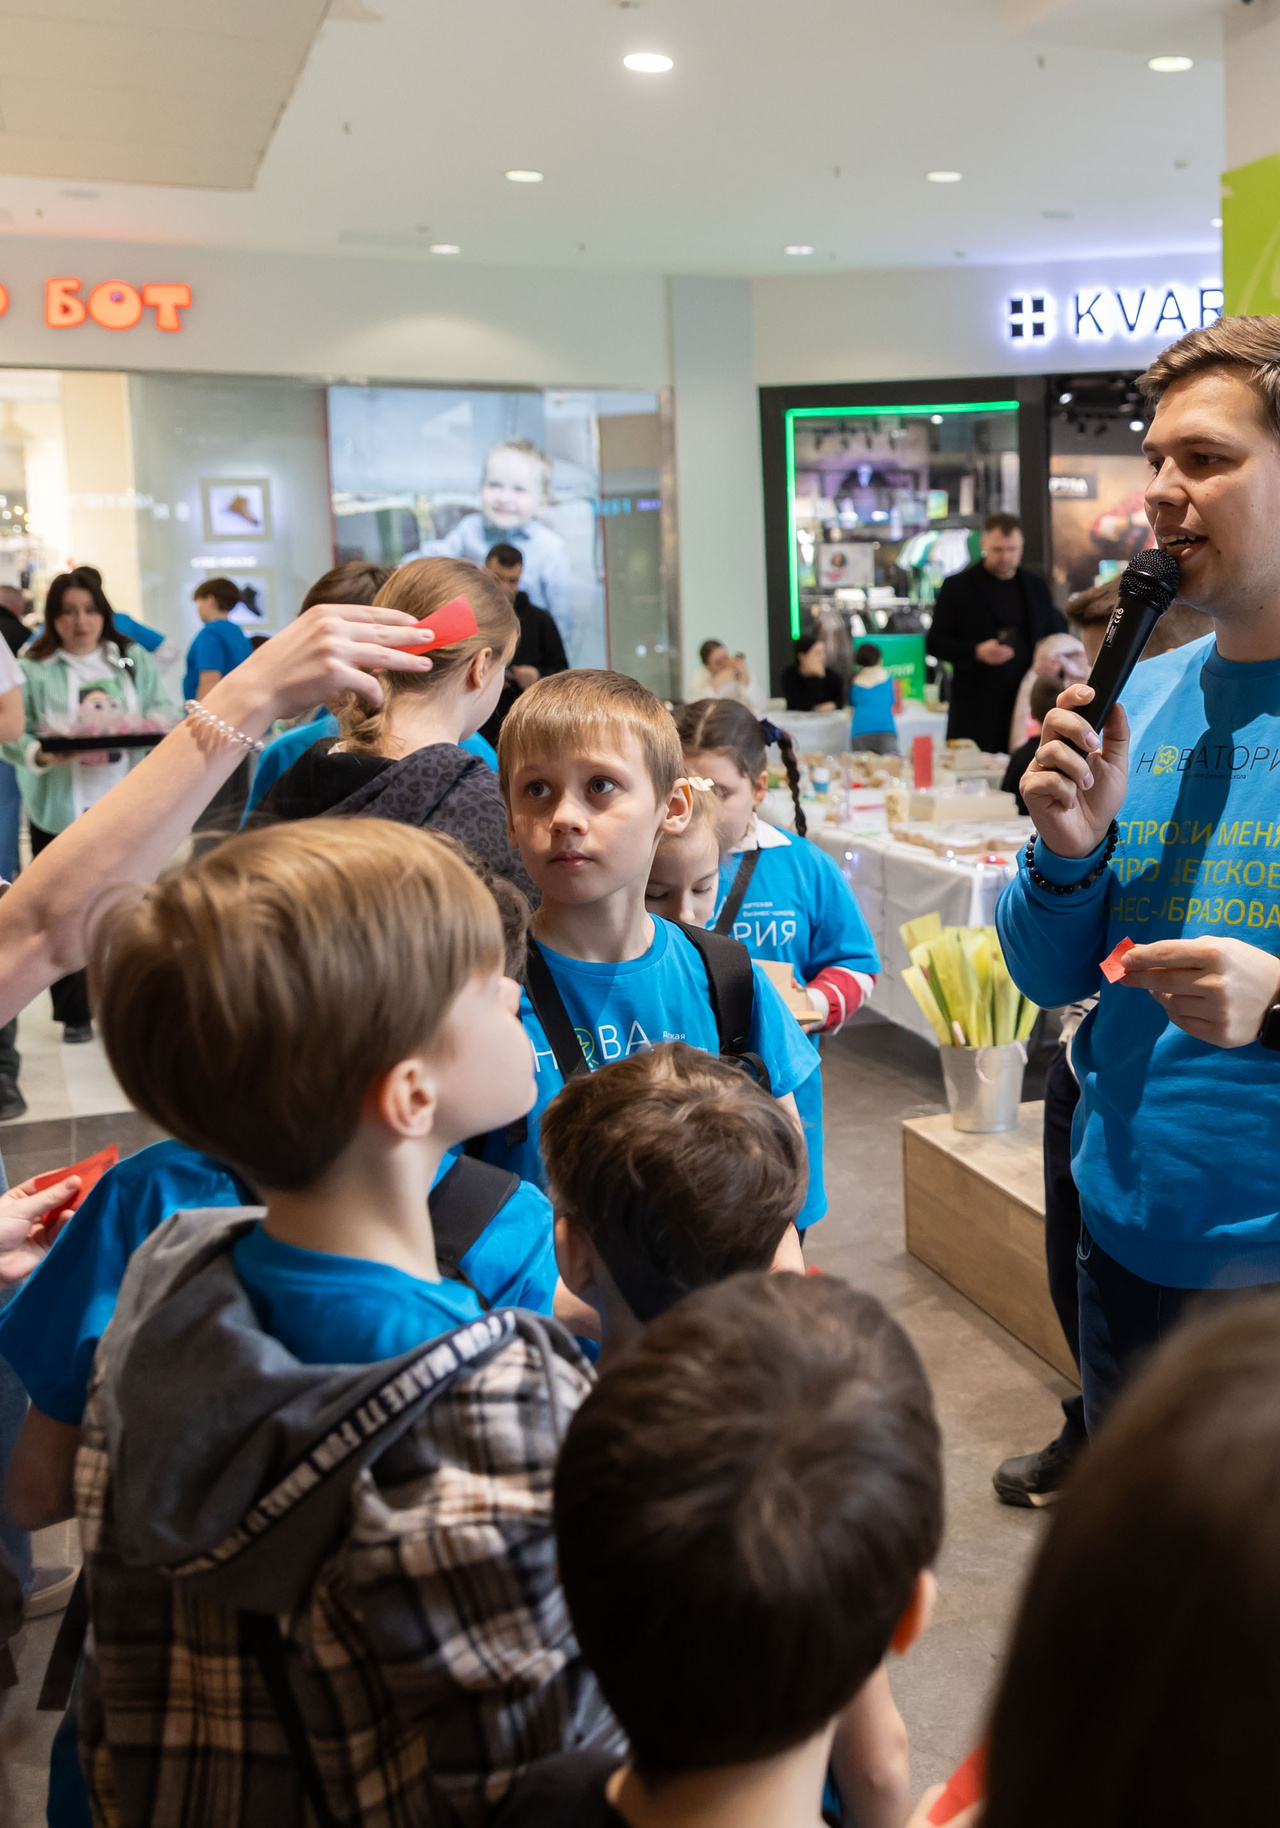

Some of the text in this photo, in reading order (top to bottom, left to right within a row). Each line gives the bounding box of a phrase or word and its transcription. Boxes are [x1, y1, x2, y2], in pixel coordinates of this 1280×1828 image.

[45, 277, 192, 332] БОТ
[1110, 858, 1160, 882] ПРО
[733, 920, 797, 947] РИЯ
